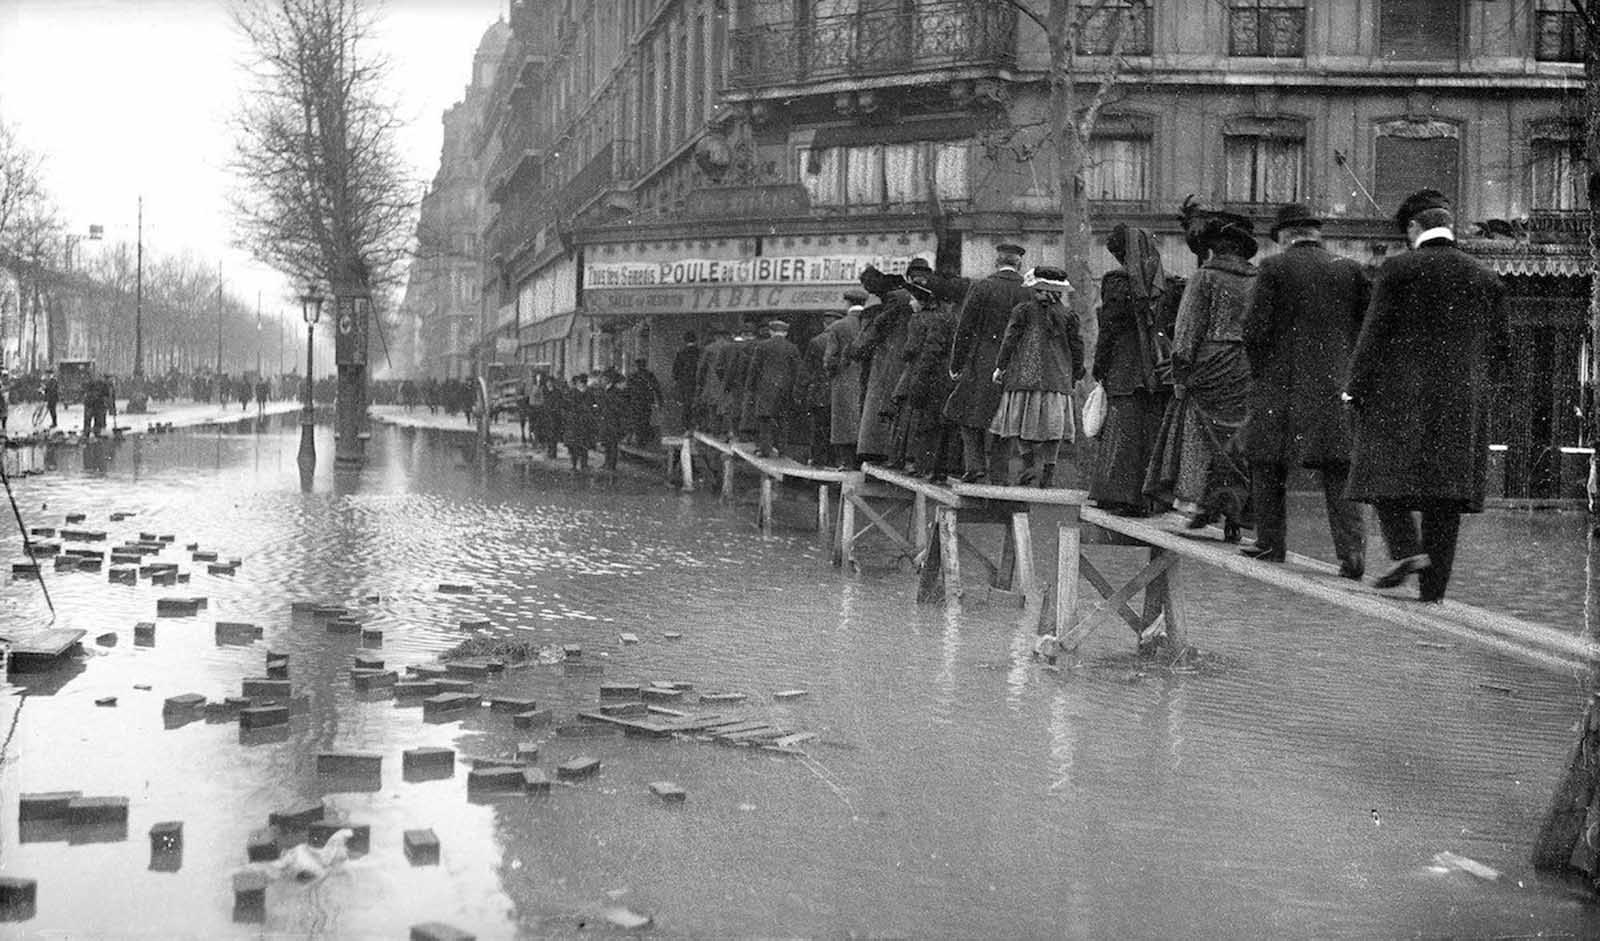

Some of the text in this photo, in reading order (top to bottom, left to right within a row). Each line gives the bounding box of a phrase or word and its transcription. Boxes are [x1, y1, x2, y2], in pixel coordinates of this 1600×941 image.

[660, 261, 720, 285] POULE
[738, 257, 806, 283] GIBIER
[823, 257, 857, 281] Billard
[692, 285, 784, 309] TABAC
